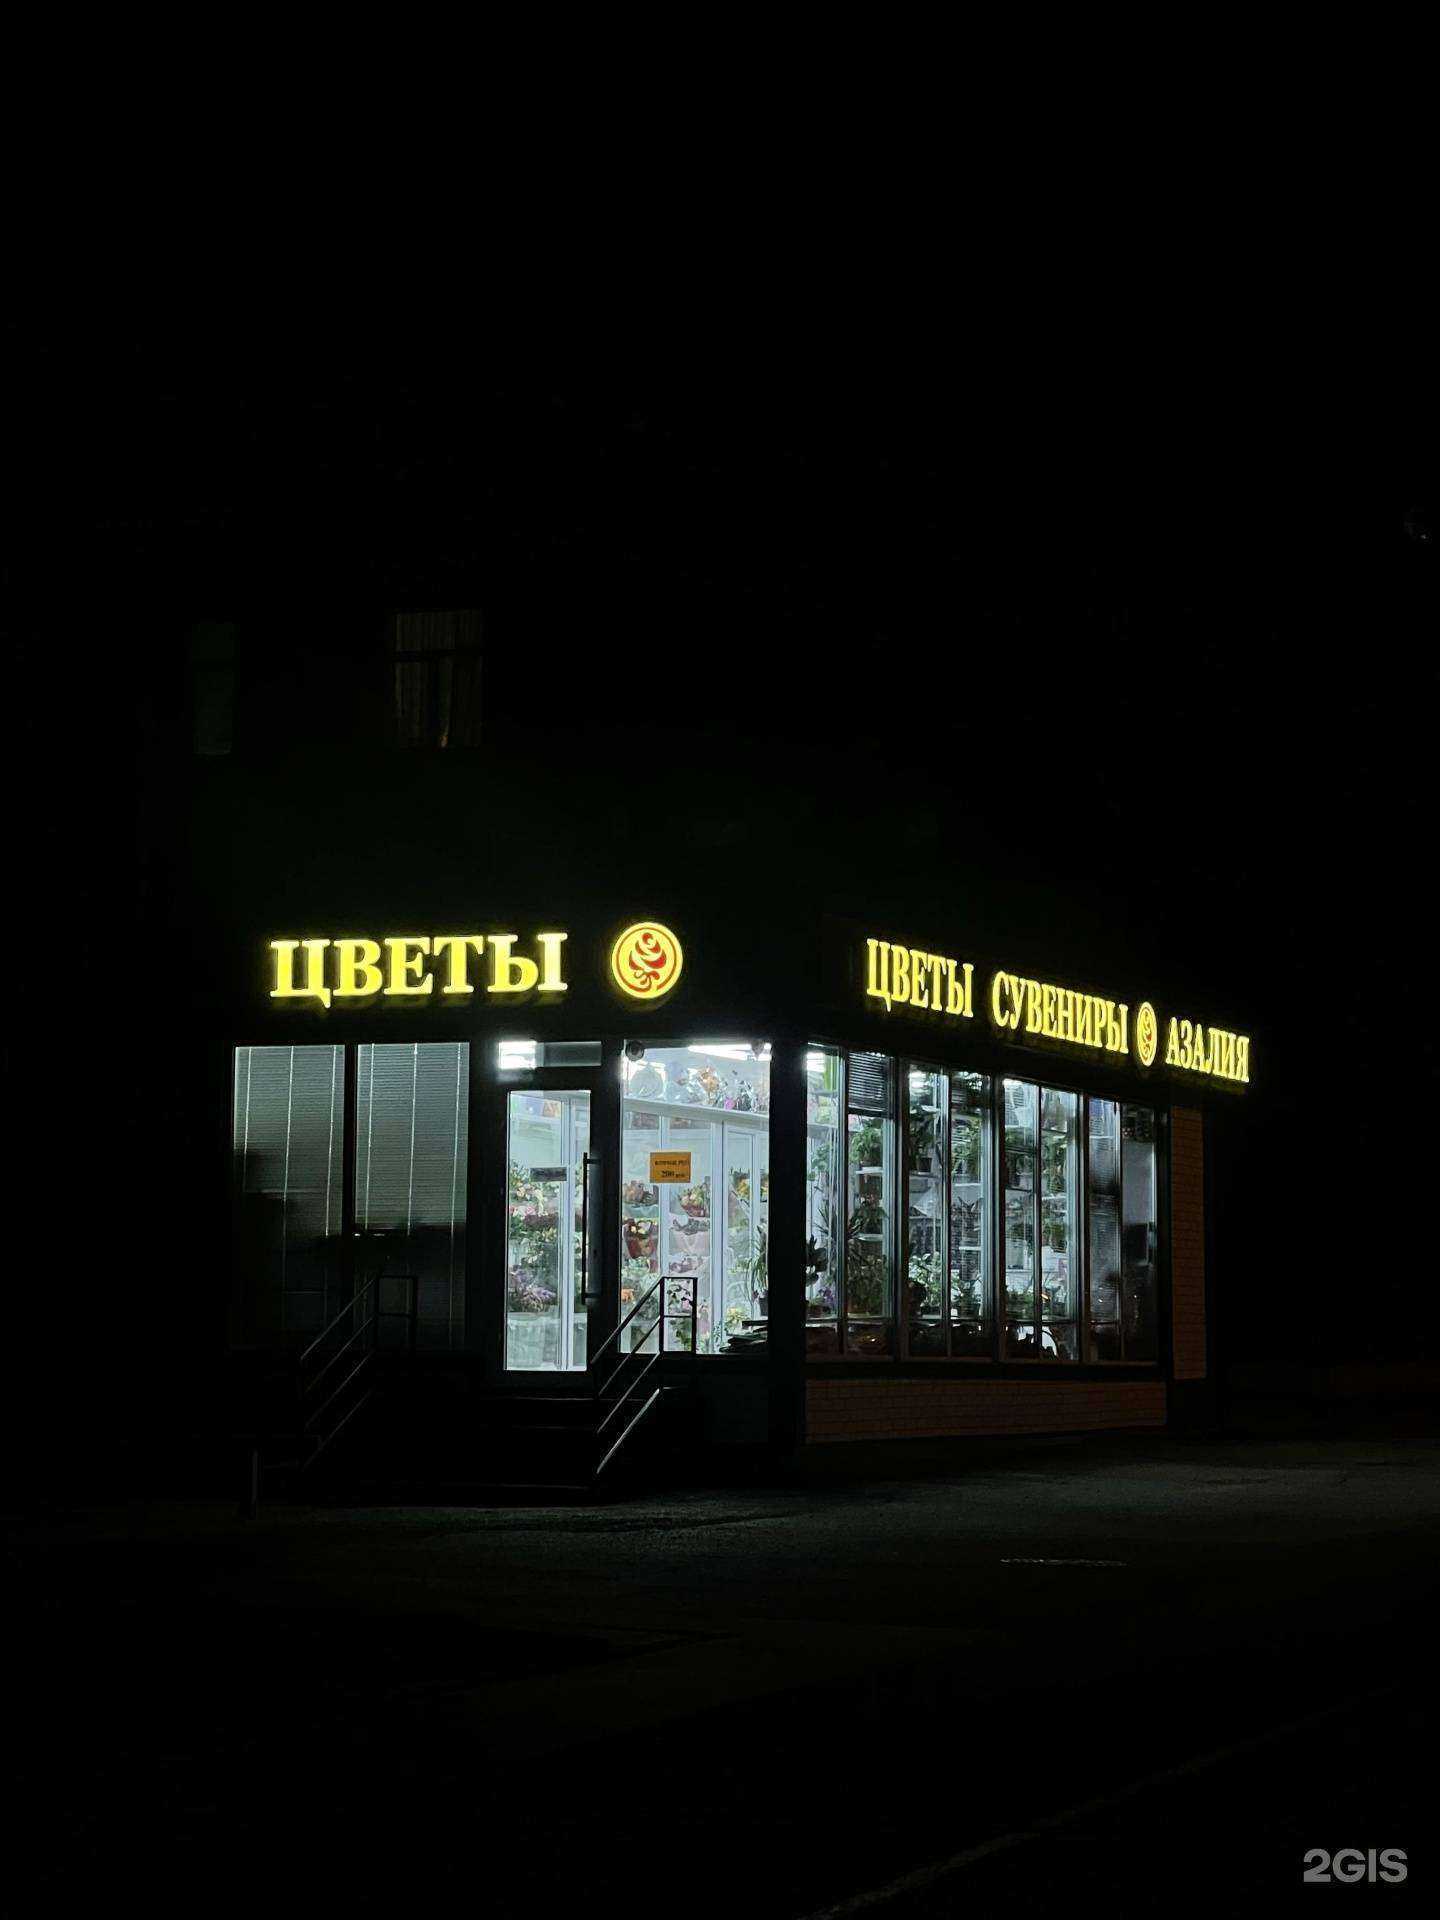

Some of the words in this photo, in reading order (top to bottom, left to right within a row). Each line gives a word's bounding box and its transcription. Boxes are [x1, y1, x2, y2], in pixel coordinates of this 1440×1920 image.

[269, 932, 568, 1009] ЦВЕТЫ
[866, 938, 975, 1018] ЦВЕТЫ
[991, 970, 1129, 1055] СУВЕНИРЫ
[1165, 1016, 1250, 1083] АЗАЛИЯ
